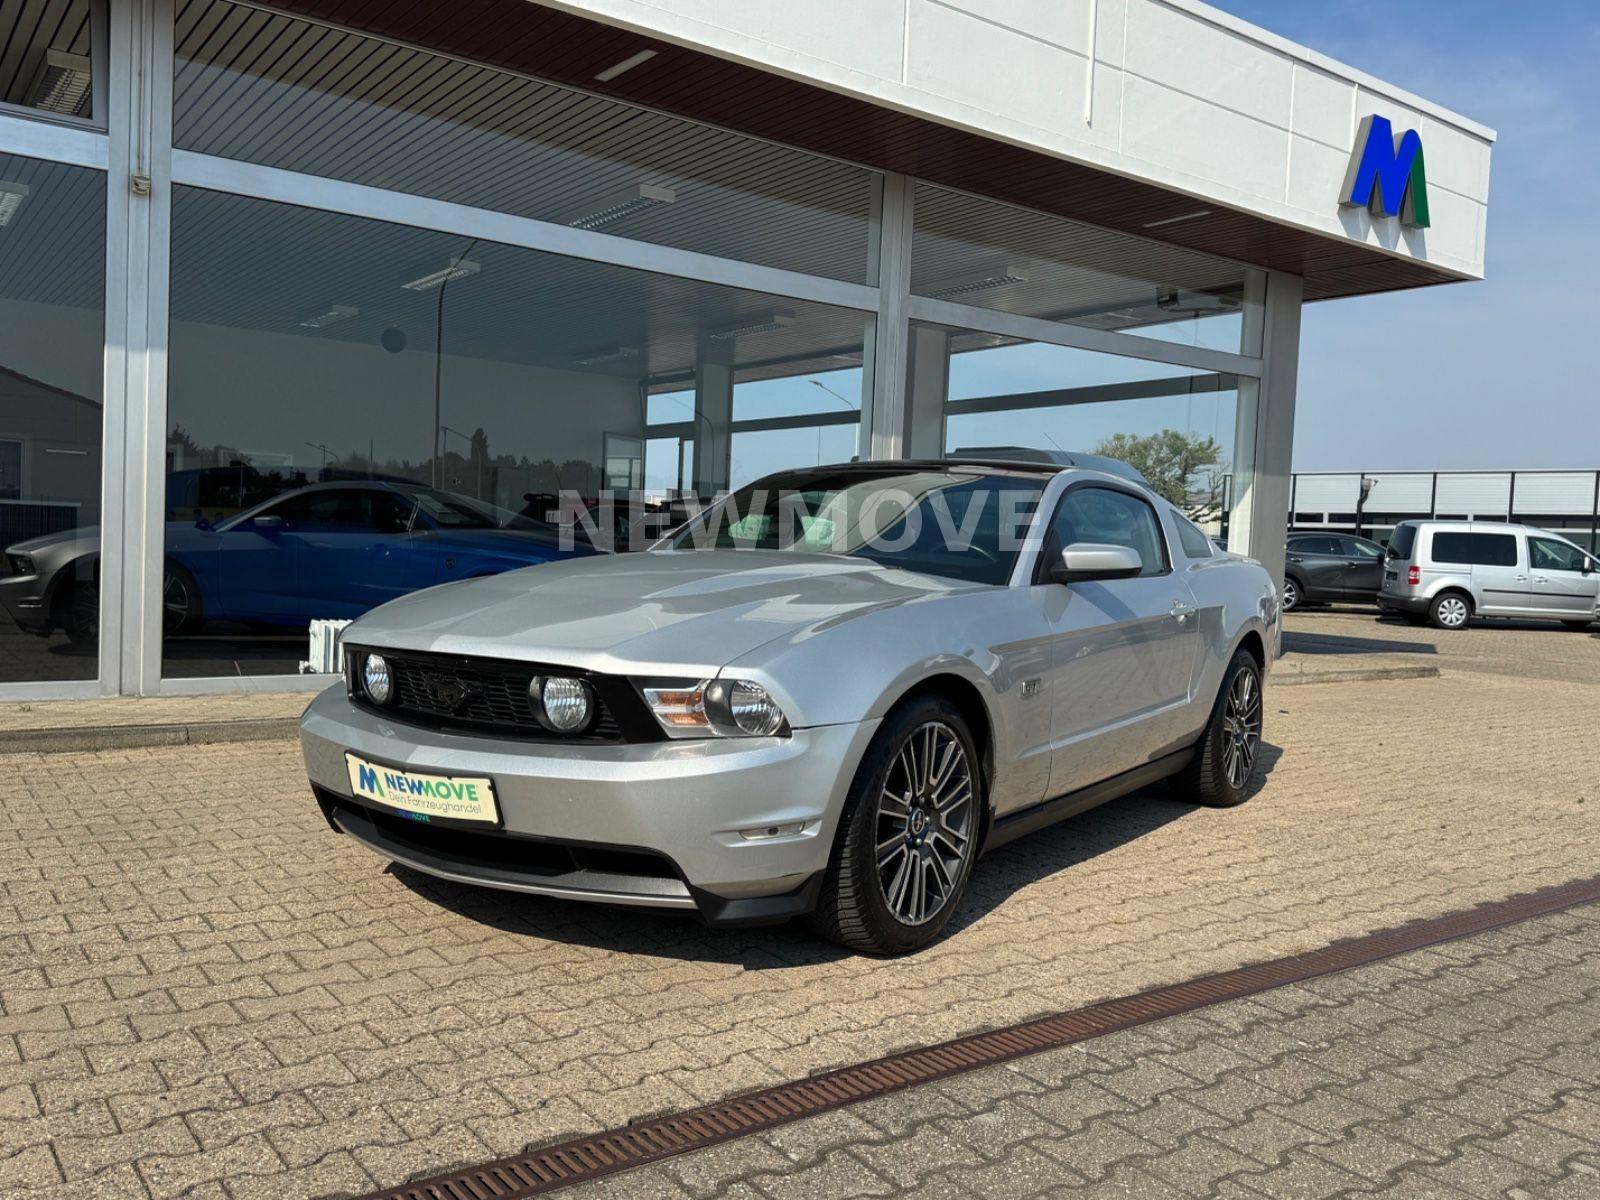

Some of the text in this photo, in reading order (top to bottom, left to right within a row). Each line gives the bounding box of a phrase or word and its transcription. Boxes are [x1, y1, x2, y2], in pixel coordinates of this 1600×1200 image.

[384, 772, 479, 801] NEWMOVE
[389, 791, 482, 813] Dein Fahrzeughandel
